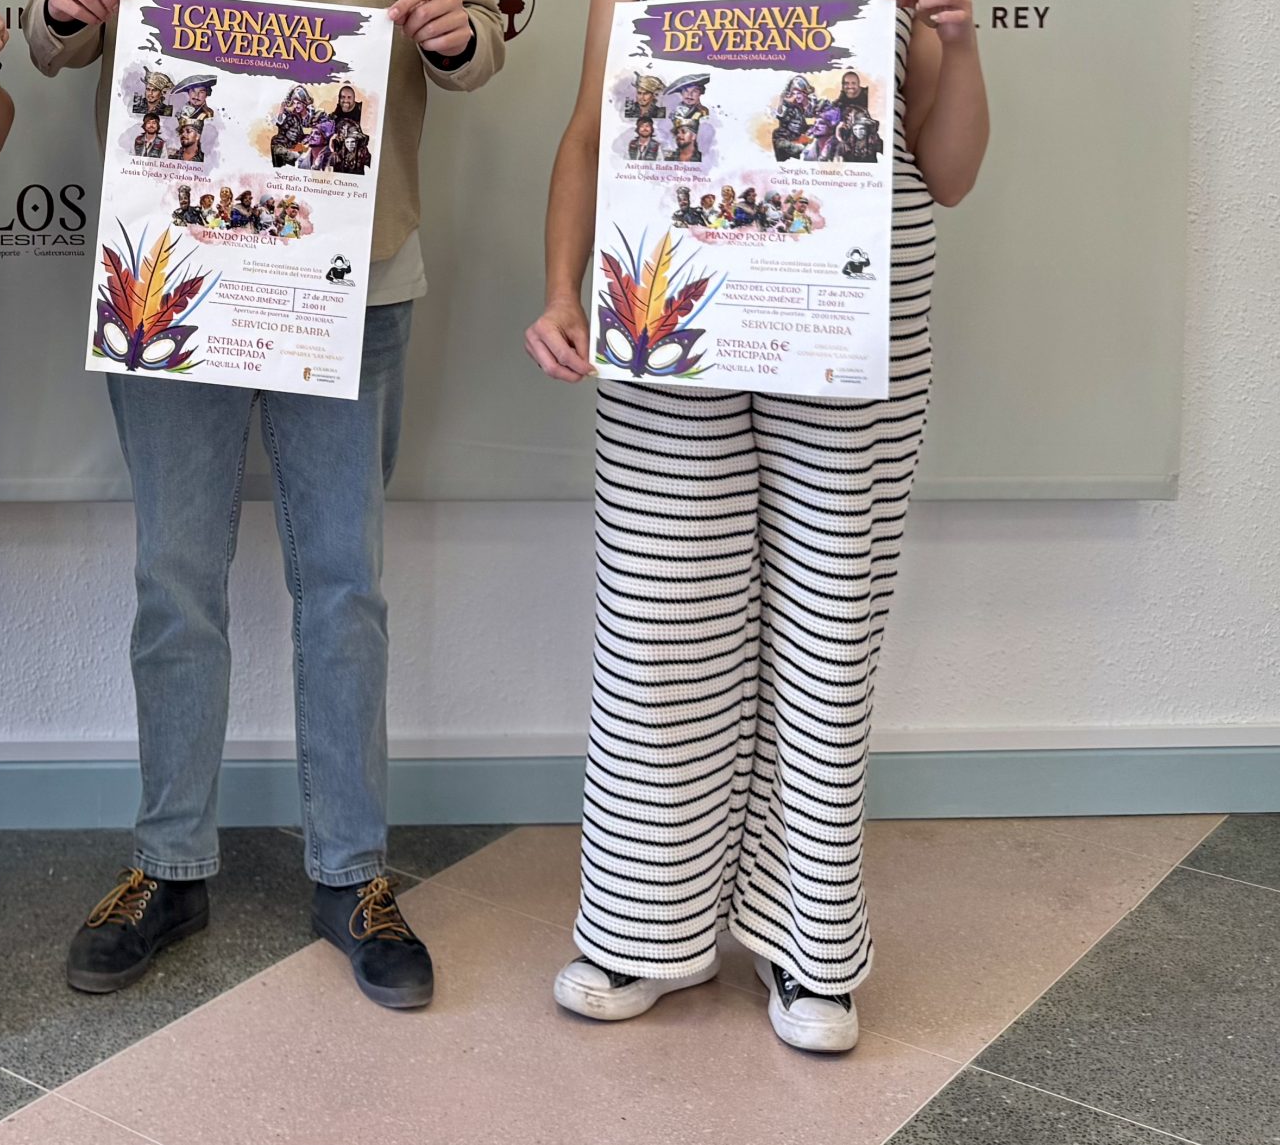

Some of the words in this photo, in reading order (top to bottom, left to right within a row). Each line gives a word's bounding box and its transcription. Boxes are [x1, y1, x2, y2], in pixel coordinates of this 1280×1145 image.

[171, 3, 181, 25] I
[183, 5, 331, 40] CARNAVAL
[662, 11, 671, 30] I
[673, 5, 827, 30] CARNAVAL
[992, 6, 1050, 29] REY
[172, 26, 213, 52] DE
[213, 31, 334, 63] VERANO
[663, 30, 704, 51] DE
[705, 28, 832, 50] VERANO
[215, 56, 253, 65] CAMPILLOS
[202, 230, 238, 241] PIANDO
[240, 234, 259, 243] POR
[34, 247, 85, 257] Gastronomia
[219, 282, 239, 290] PATIO
[255, 286, 287, 295] COLEGIO
[320, 294, 343, 303] JUNIO
[231, 318, 278, 332] SERVICIO
[280, 323, 294, 333] DE
[295, 325, 330, 337] BARRA
[741, 319, 792, 332] SERVICIO
[795, 323, 811, 332] DE
[812, 324, 852, 335] BARRA
[207, 335, 253, 348] ENTRADA
[255, 338, 274, 350] 6€
[716, 338, 767, 350] ENTRADA
[770, 339, 790, 351] 6€
[206, 345, 266, 359] ANTICIPADA
[716, 349, 782, 361] ANTICIPADA
[205, 359, 240, 369] TAQUILLA
[243, 361, 261, 372] 10€
[716, 363, 754, 372] TAQUILLA
[758, 364, 778, 374] 10€
